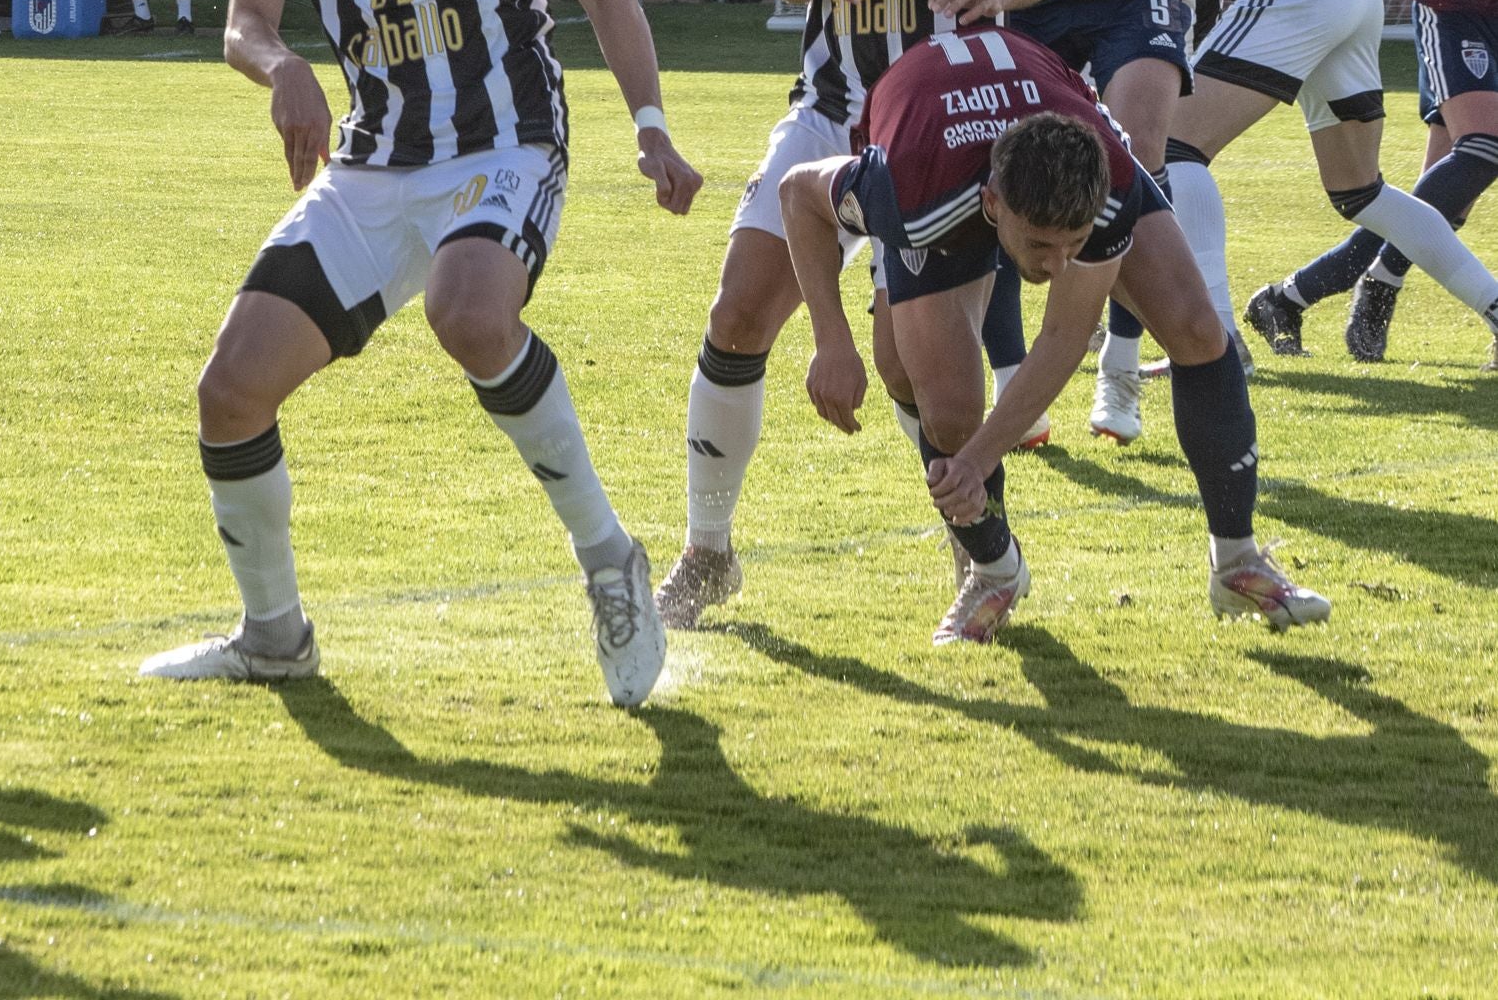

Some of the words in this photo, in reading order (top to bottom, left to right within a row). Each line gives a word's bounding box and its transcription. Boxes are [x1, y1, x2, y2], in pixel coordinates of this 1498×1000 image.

[928, 31, 1016, 71] 11
[1149, 40, 1177, 49] adidas
[940, 83, 1011, 116] LÓPEZ
[943, 118, 1019, 140] PALOMO
